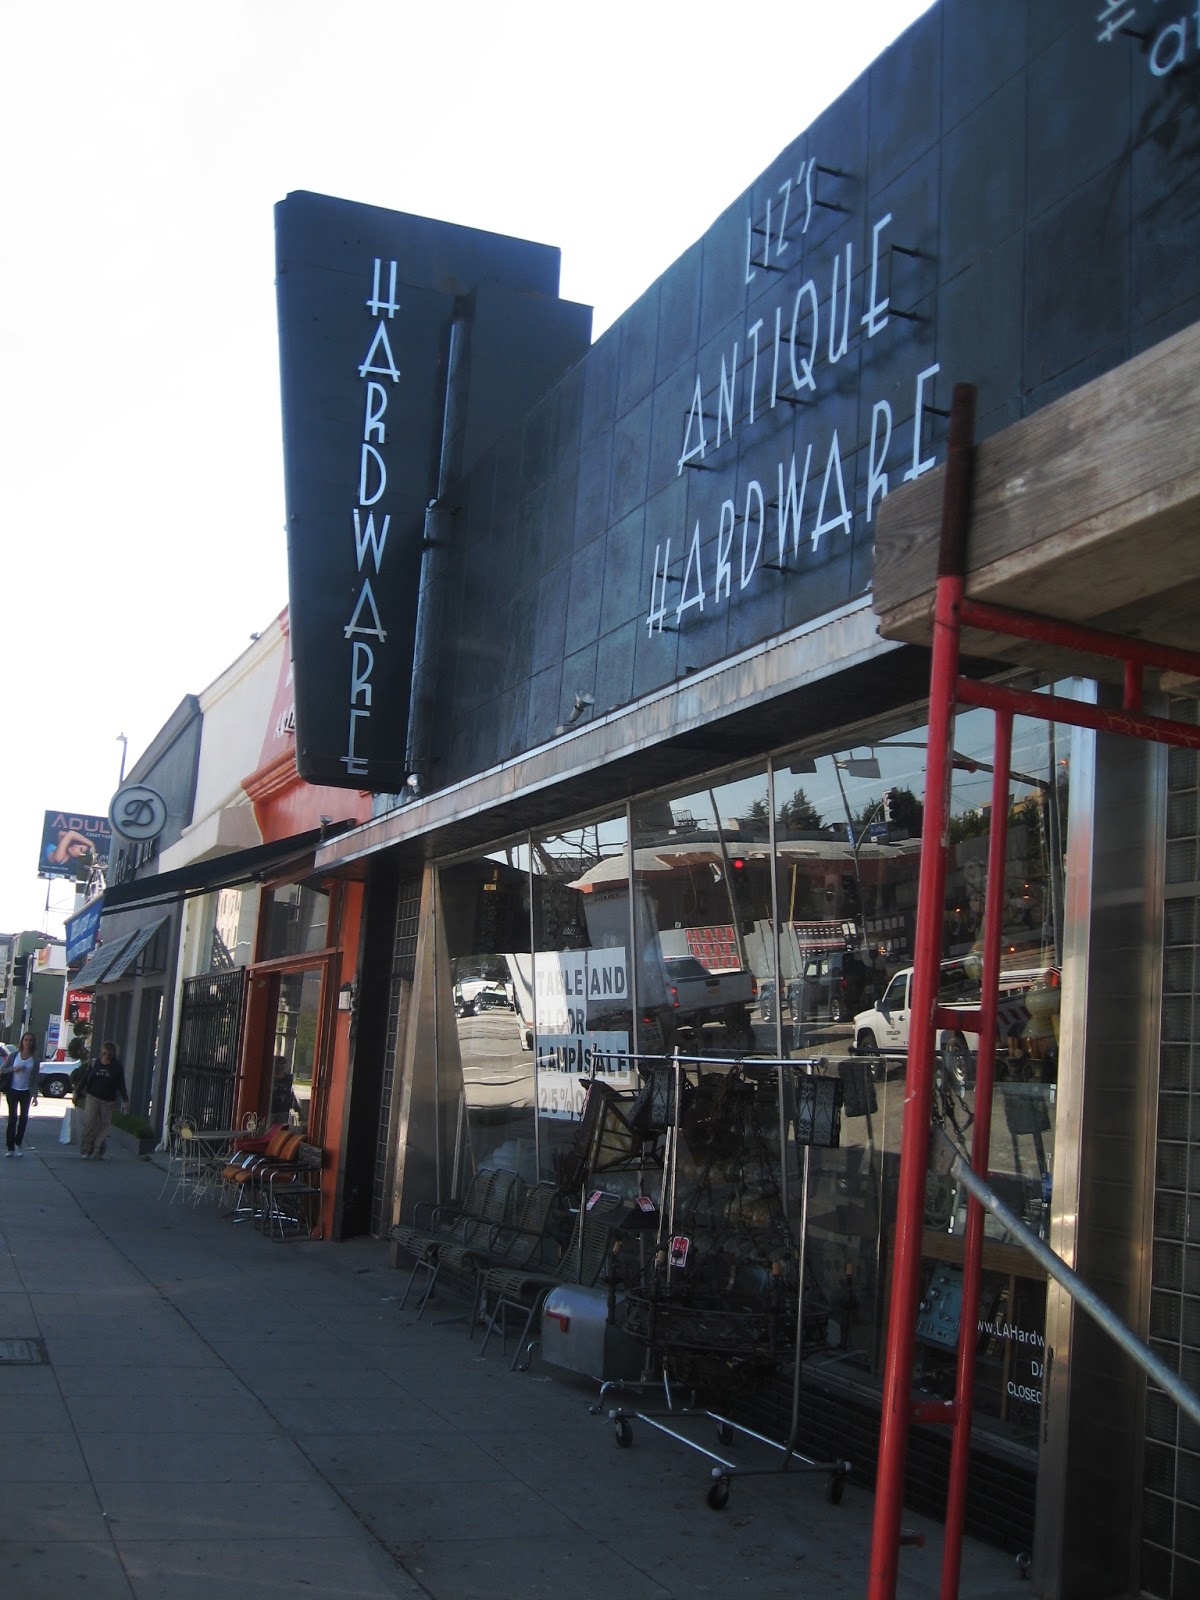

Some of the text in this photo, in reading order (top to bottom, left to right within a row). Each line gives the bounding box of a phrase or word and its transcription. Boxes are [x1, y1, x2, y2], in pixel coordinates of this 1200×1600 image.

[744, 157, 816, 284] LIZ'S
[677, 213, 892, 477] ANTIQUE
[339, 257, 401, 777] HARDWARE
[646, 362, 940, 639] HARDWARE
[536, 965, 626, 997] TABLE AND
[537, 1007, 585, 1036] FLOOR
[539, 1045, 629, 1079] LAMP SALE
[540, 1087, 573, 1115] 25%
